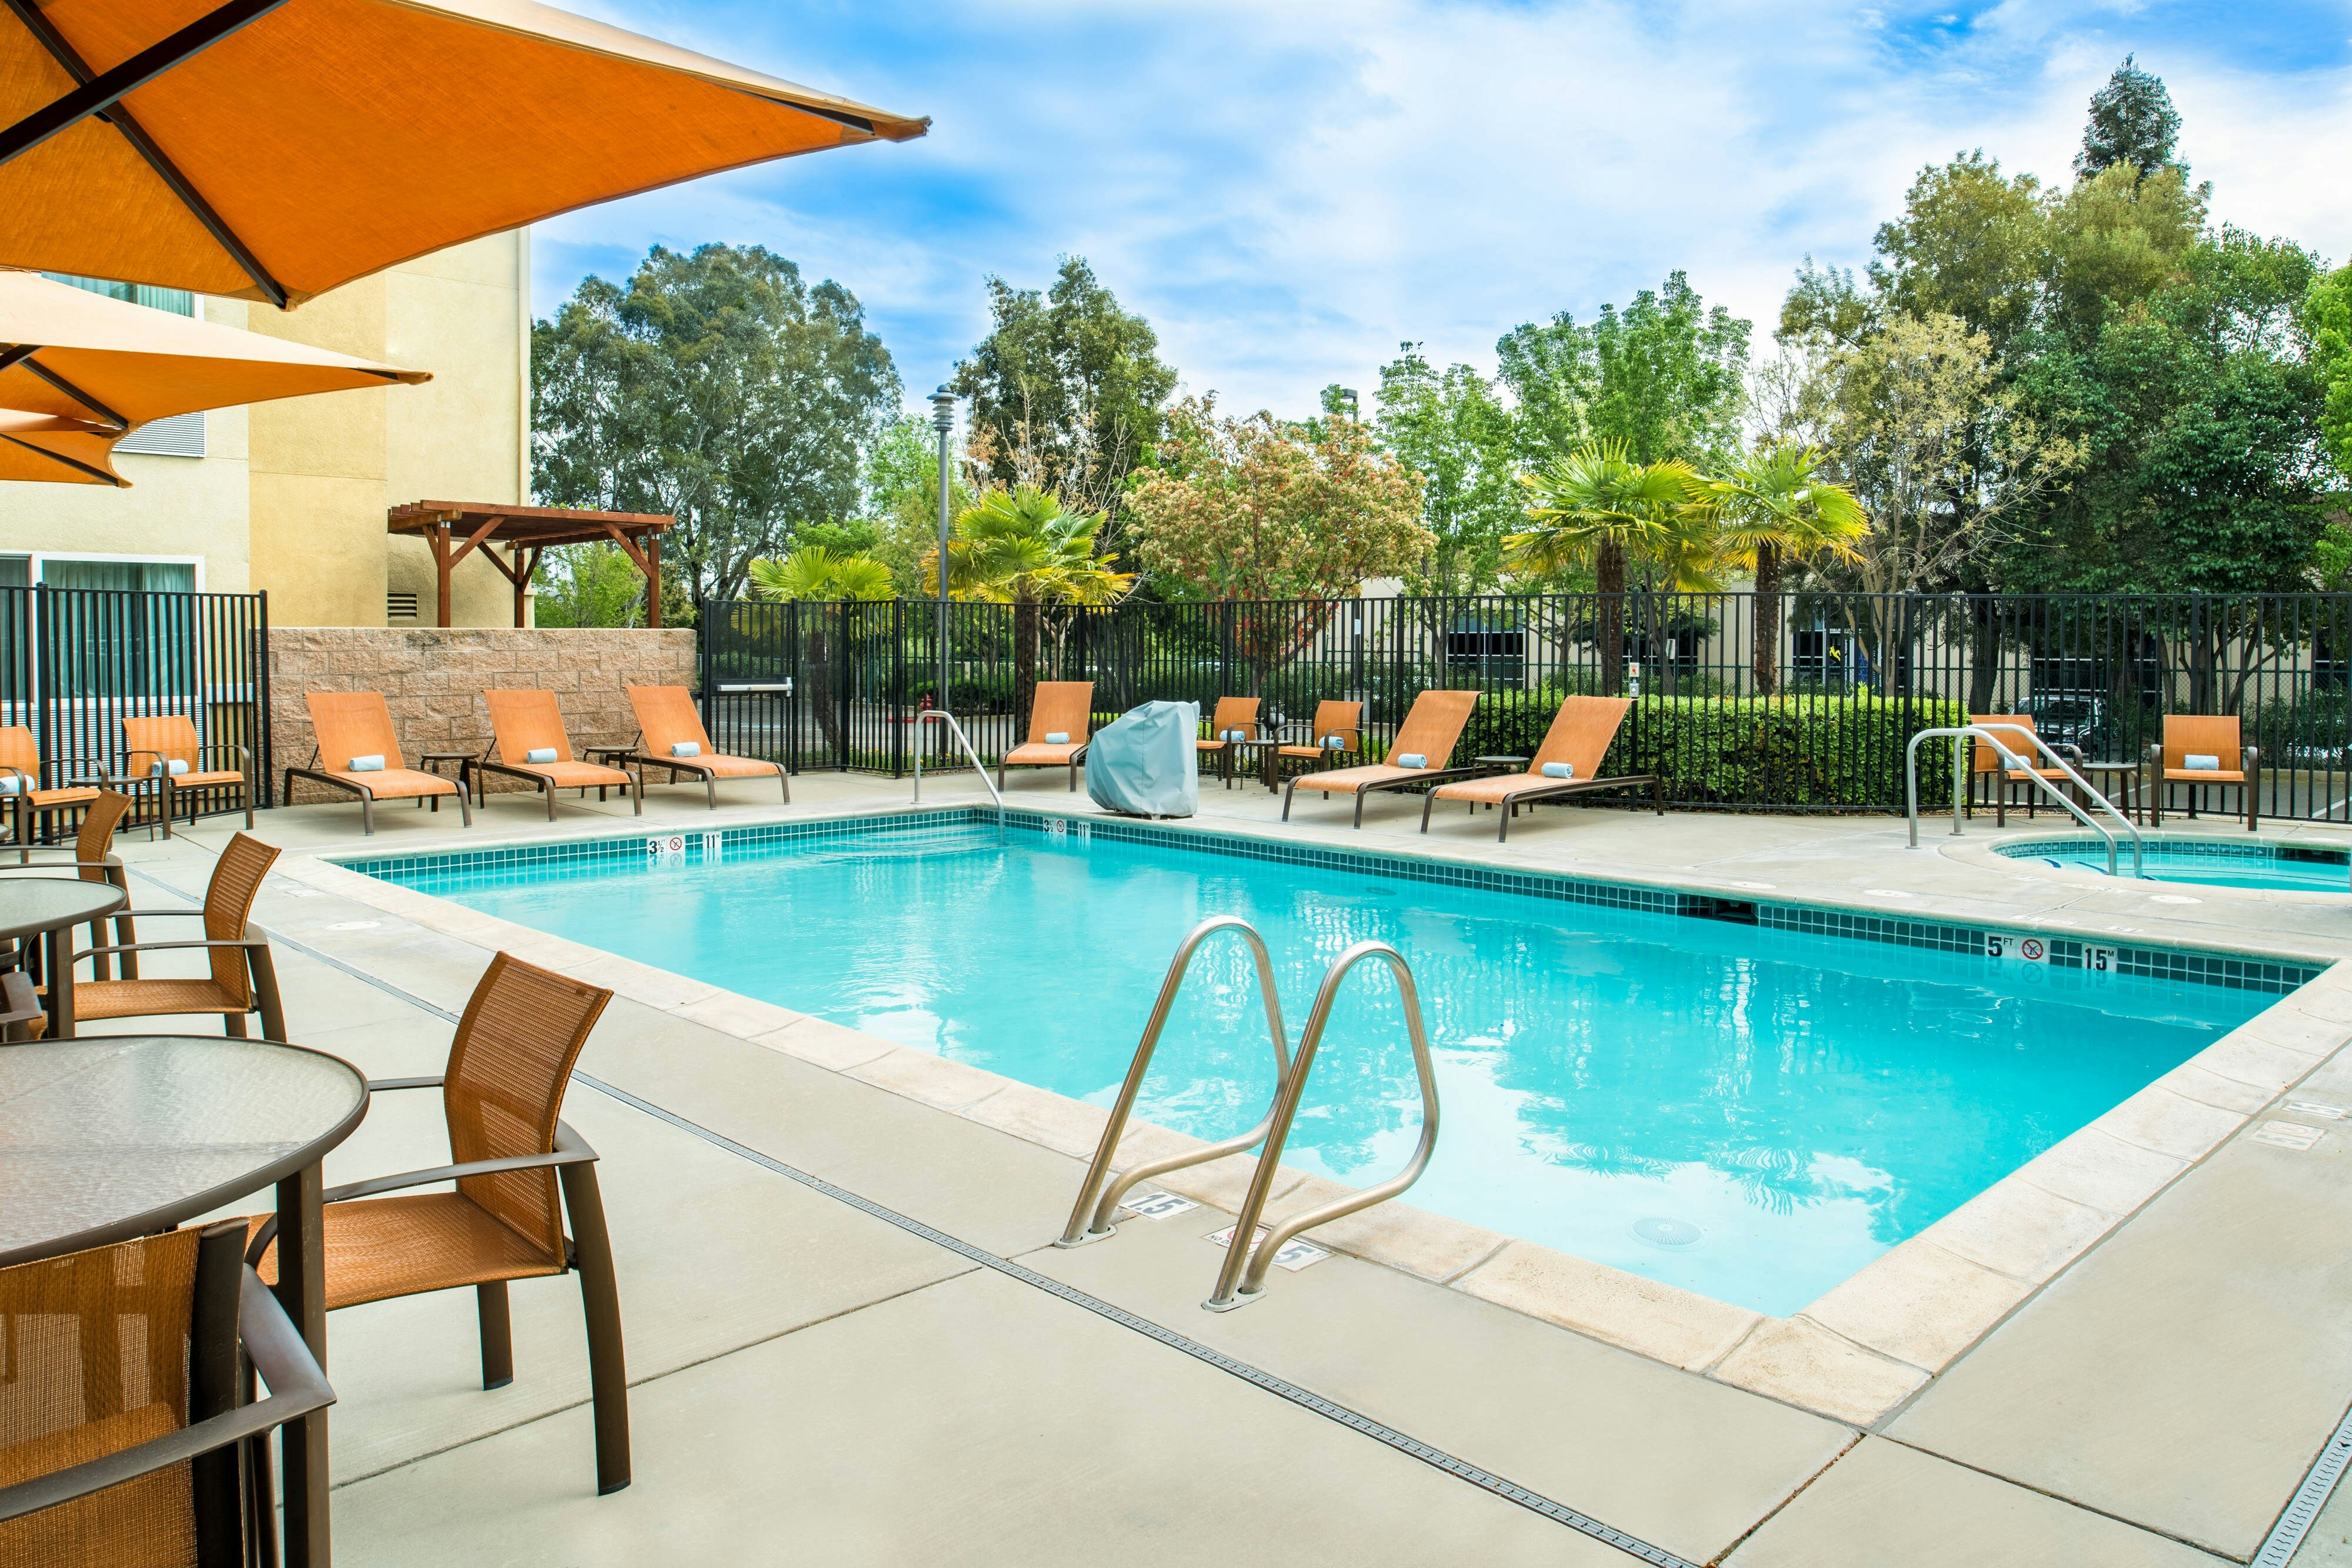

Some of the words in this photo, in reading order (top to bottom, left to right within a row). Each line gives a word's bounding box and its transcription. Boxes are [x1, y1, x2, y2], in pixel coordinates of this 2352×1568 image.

[1987, 935, 2003, 958] 5
[2003, 937, 2014, 946] FT
[2084, 948, 2107, 971] 1.5
[1127, 1193, 1188, 1215] 1.5
